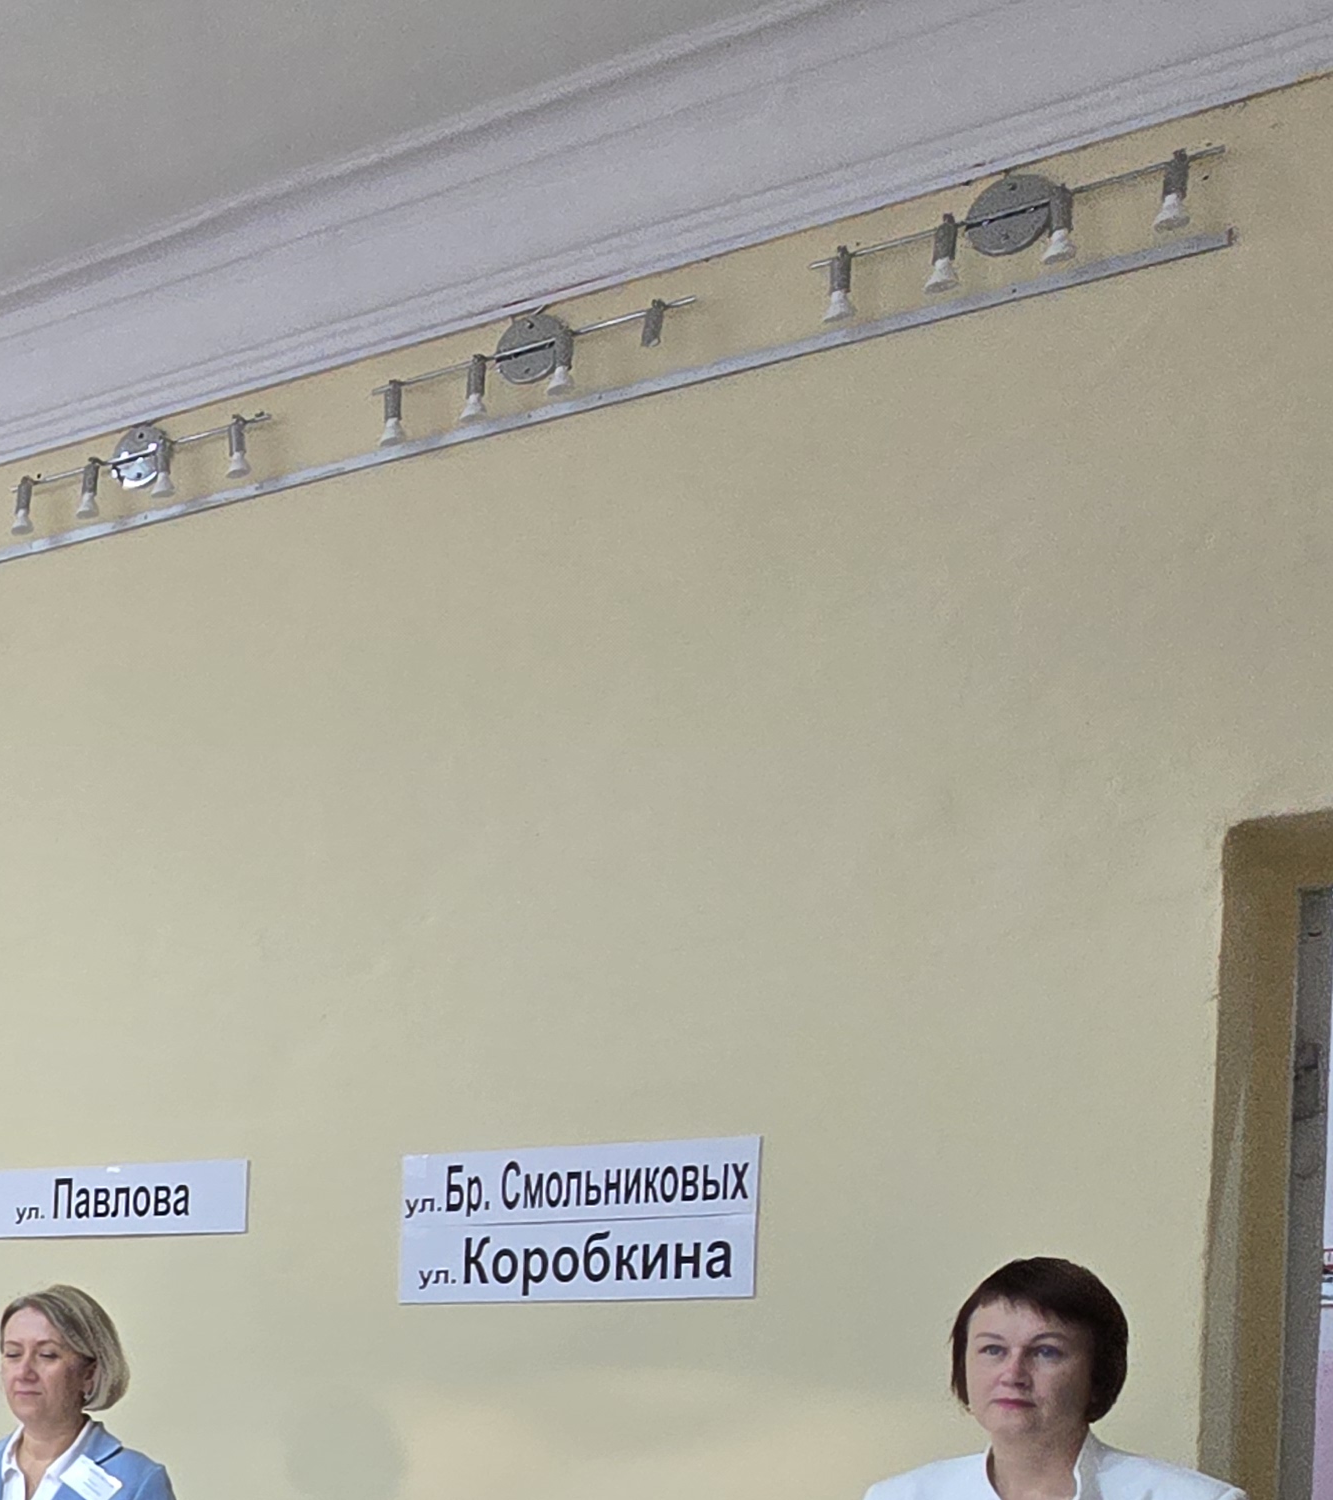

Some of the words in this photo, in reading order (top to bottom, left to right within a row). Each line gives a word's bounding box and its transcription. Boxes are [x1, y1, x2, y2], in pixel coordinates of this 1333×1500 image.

[15, 1206, 45, 1224] ул.
[52, 1177, 190, 1219] Павлова
[445, 1165, 490, 1217] Бр.
[501, 1161, 750, 1210] Смольниковых
[418, 1269, 457, 1290] ул.
[463, 1230, 732, 1296] Коробкина
